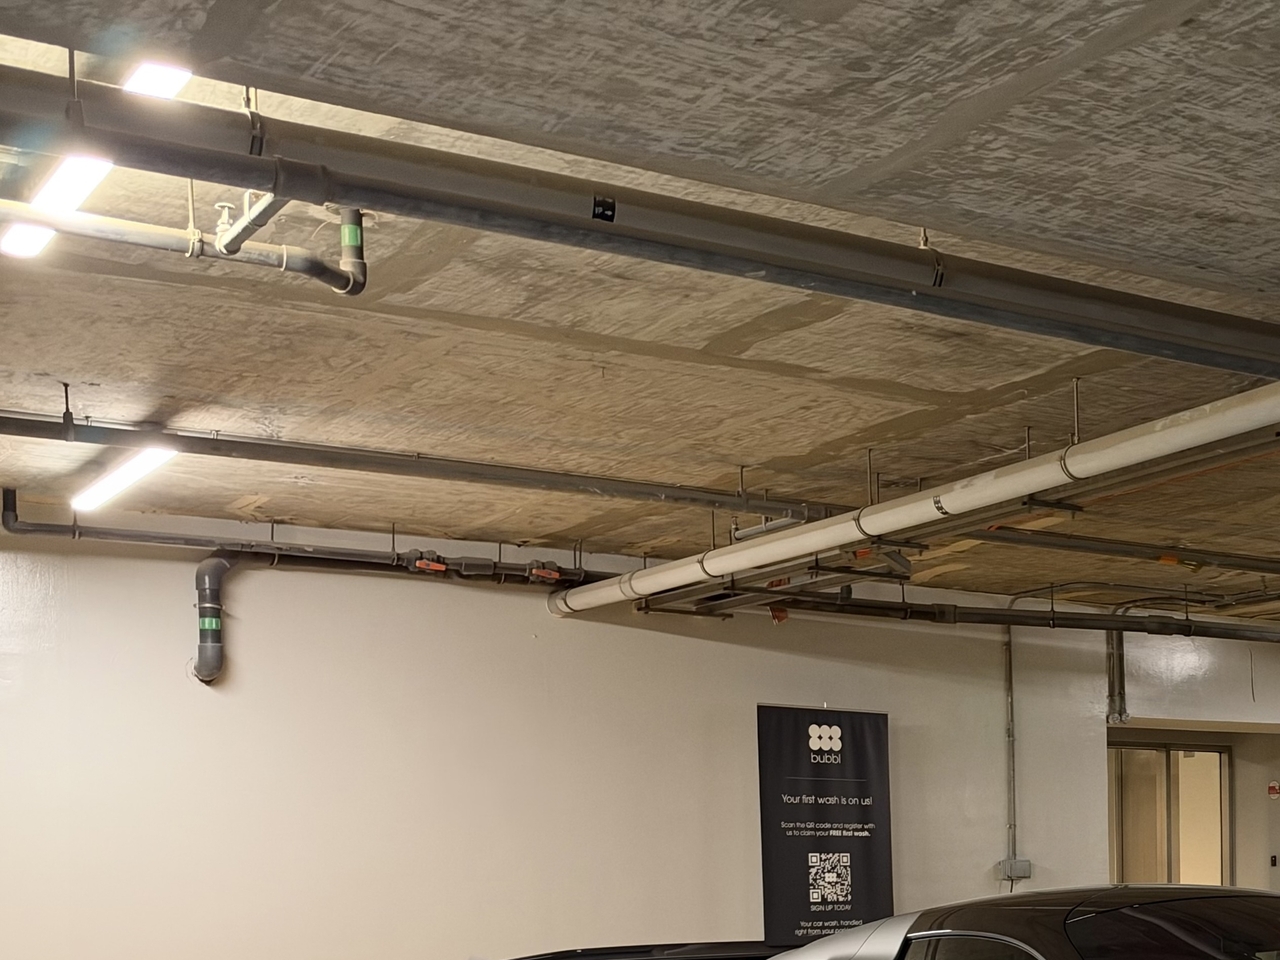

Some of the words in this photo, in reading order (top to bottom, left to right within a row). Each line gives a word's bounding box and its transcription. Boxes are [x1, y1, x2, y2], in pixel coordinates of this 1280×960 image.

[810, 752, 842, 764] bubbl
[781, 794, 800, 803] Your
[802, 794, 815, 804] first
[817, 795, 839, 804] wash
[841, 796, 847, 804] is
[848, 797, 859, 805] on
[861, 797, 872, 805] us!
[806, 821, 815, 829] QR
[810, 904, 825, 912] SIGN
[794, 928, 807, 936] right
